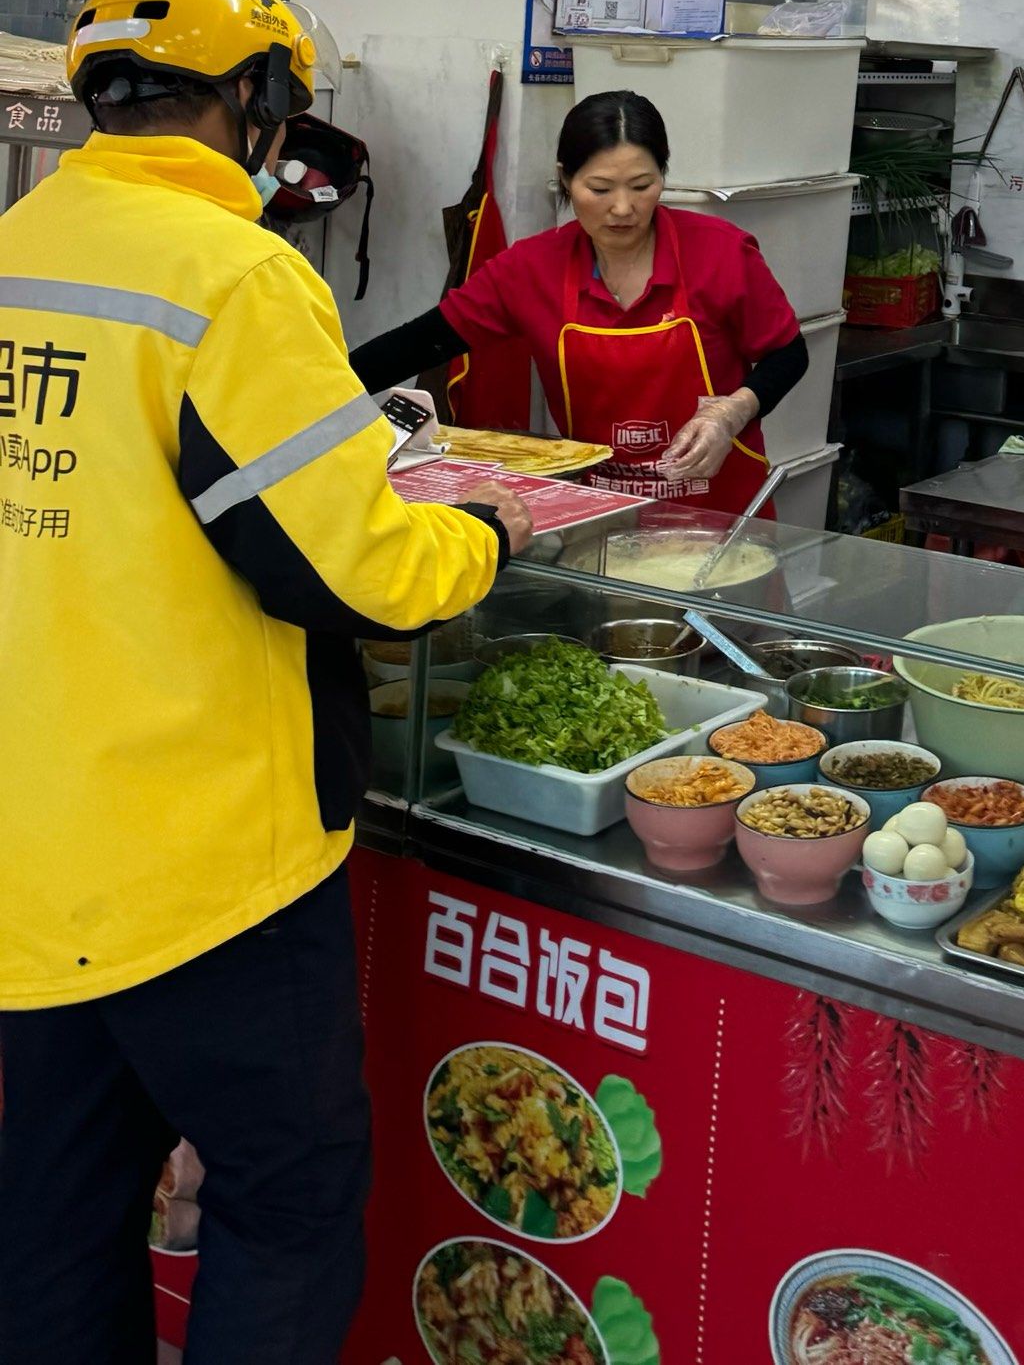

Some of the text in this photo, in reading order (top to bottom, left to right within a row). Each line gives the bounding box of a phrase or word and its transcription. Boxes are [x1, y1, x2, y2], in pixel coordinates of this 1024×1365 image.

[6, 102, 62, 132] 食品
[424, 891, 651, 1051] 百合饭包
